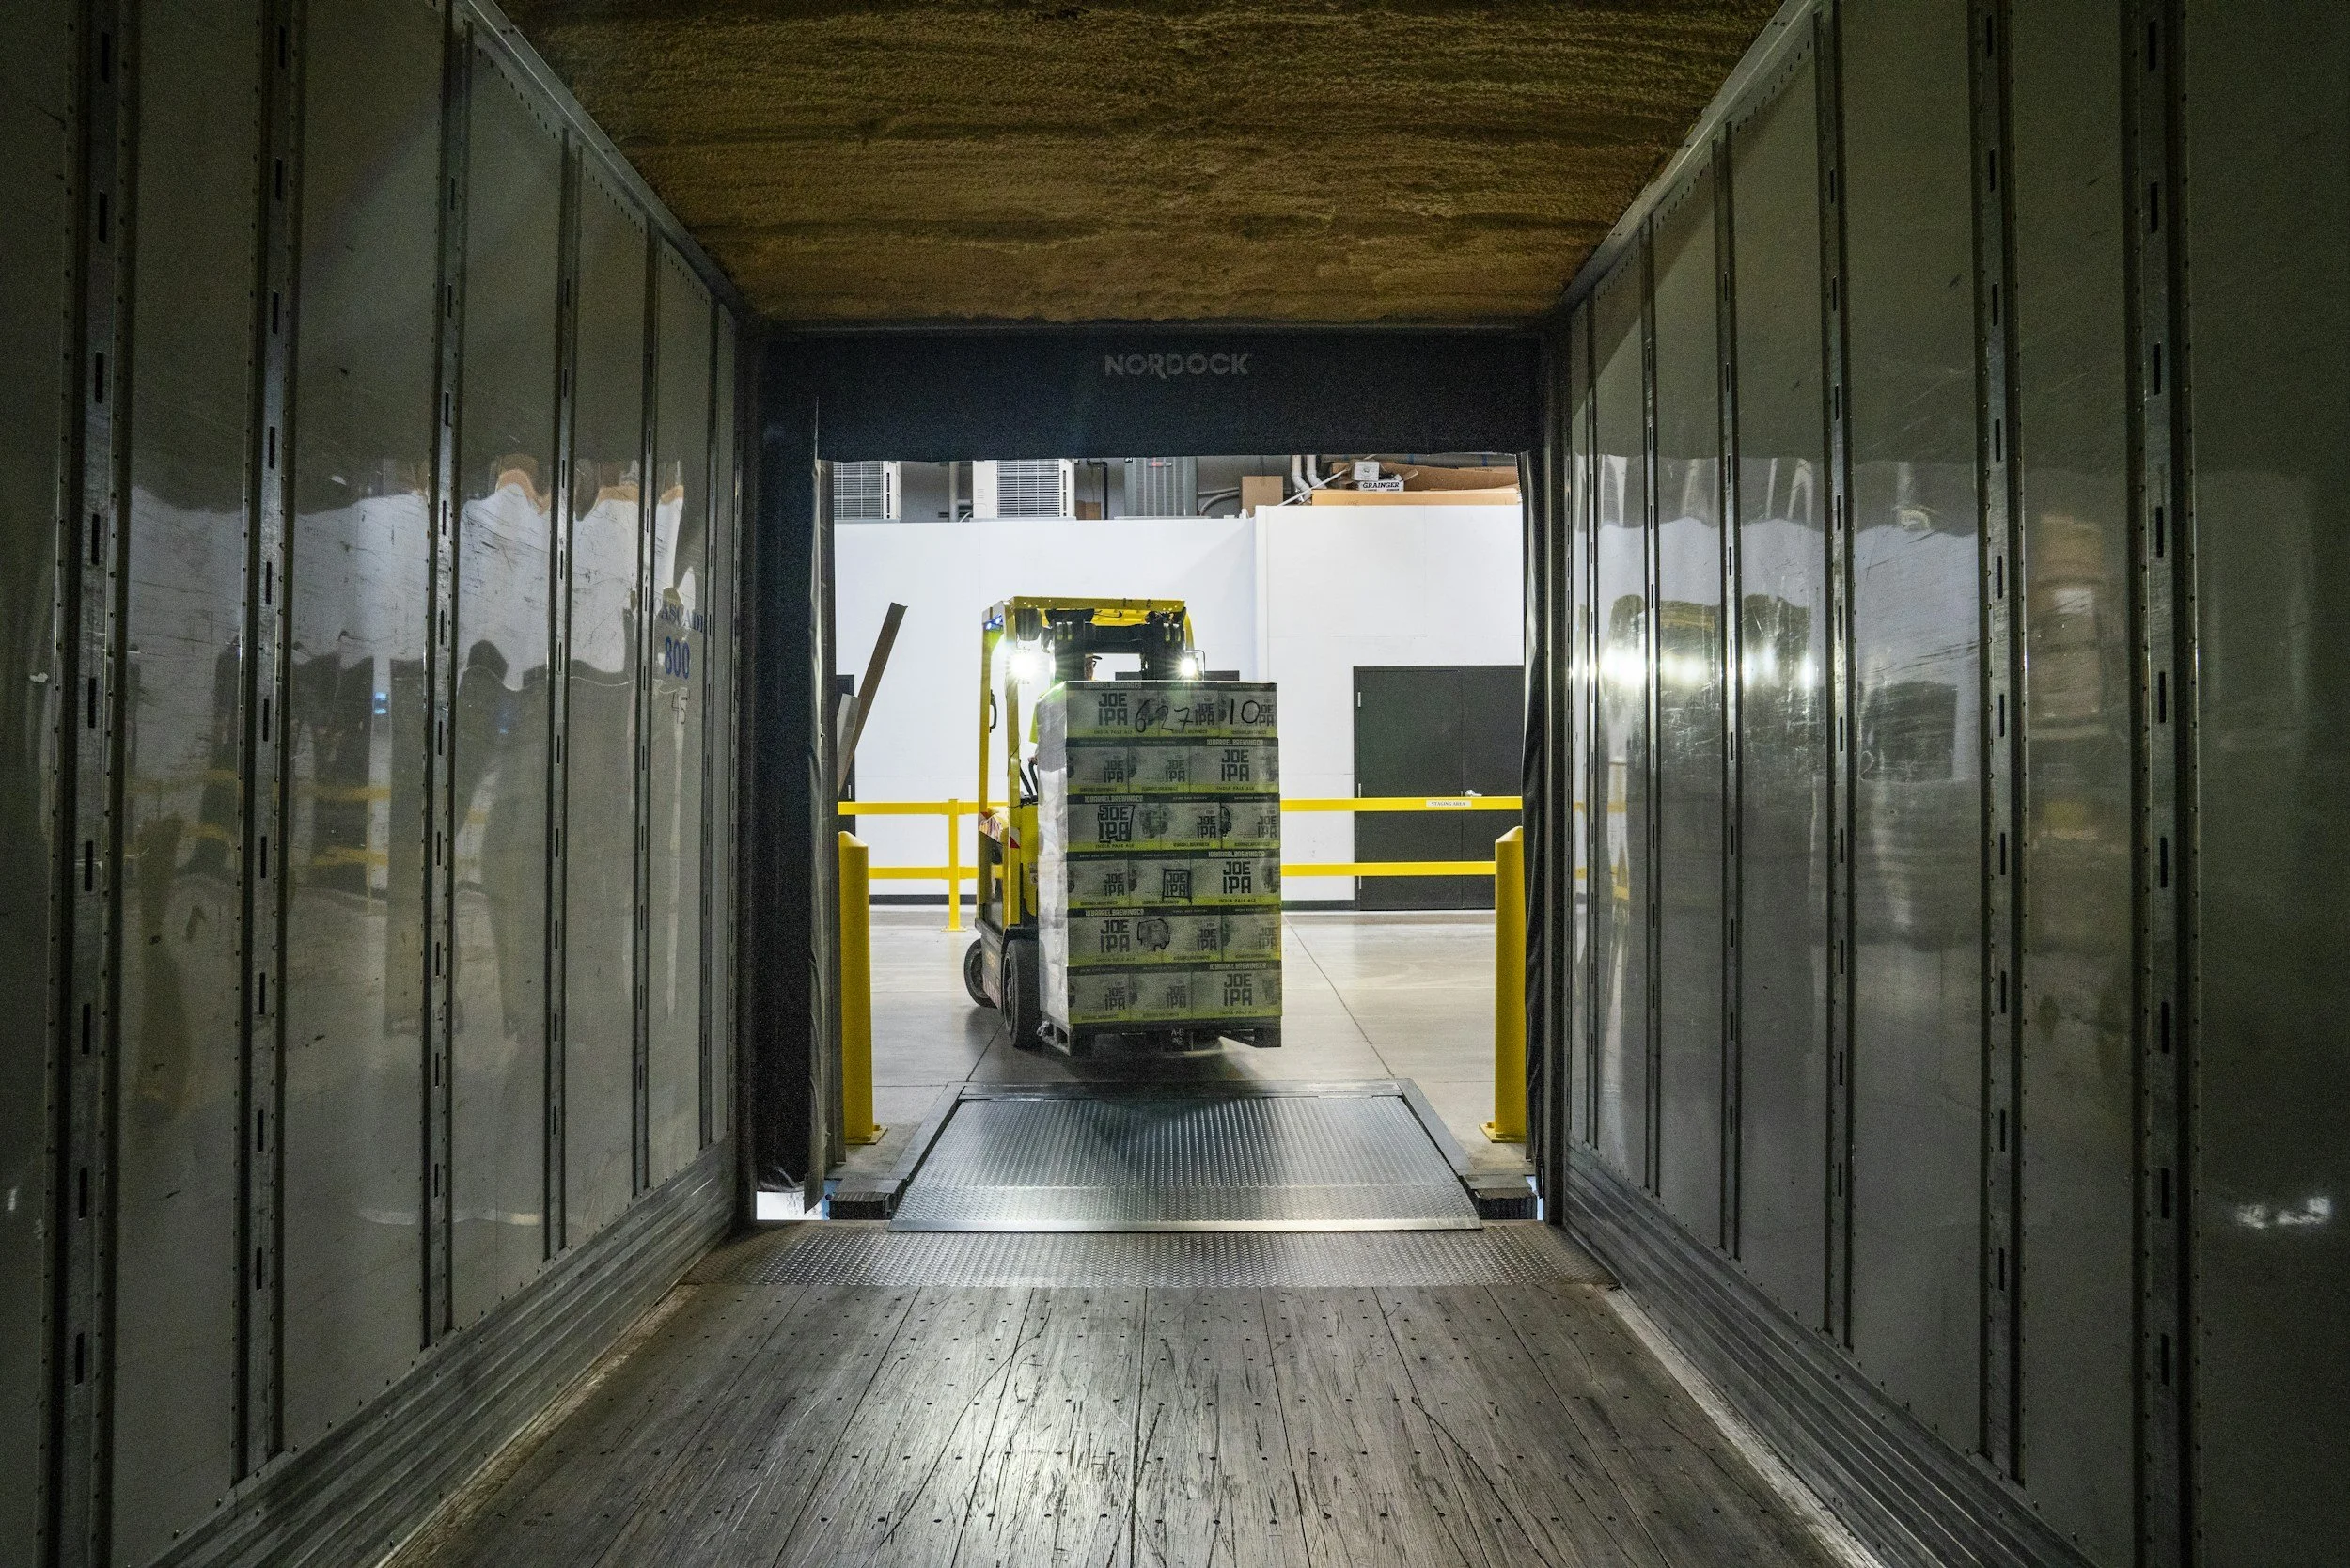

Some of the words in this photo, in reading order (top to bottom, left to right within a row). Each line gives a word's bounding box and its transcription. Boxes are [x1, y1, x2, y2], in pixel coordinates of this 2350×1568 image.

[1104, 353, 1250, 379] NORDOCK
[665, 635, 690, 679] 800
[1099, 693, 1127, 707] JOE
[1195, 703, 1214, 713] JOE
[1230, 698, 1260, 724] 10
[1258, 705, 1274, 713] OE
[1099, 708, 1128, 726] IPA
[1196, 713, 1214, 725] IPA
[1222, 749, 1249, 763] JOE
[1104, 760, 1123, 770] JOE
[1167, 760, 1184, 769] JOE
[1104, 771, 1123, 782] IPA
[1166, 771, 1185, 782] IPA
[1222, 764, 1249, 781] IPA
[1100, 807, 1128, 820] JOE
[1198, 816, 1216, 825] JOE
[1258, 816, 1277, 825] JOE
[1100, 822, 1128, 839] IPA
[1198, 826, 1216, 838] IPA
[1258, 826, 1277, 838] IPA
[1223, 861, 1250, 875] JOE
[1104, 873, 1123, 883] JOE
[1167, 873, 1185, 883] JOE
[1104, 884, 1124, 896] IPA
[1167, 884, 1185, 895] IPA
[1223, 876, 1251, 894] IPA
[1101, 920, 1129, 933] JOE
[1198, 929, 1216, 938] JOE
[1101, 934, 1130, 952] IPA
[1198, 939, 1217, 951] IPA
[1224, 974, 1252, 987] JOE
[1105, 987, 1124, 996] JOE
[1224, 988, 1252, 1006] IPA
[1105, 997, 1125, 1011] IPA
